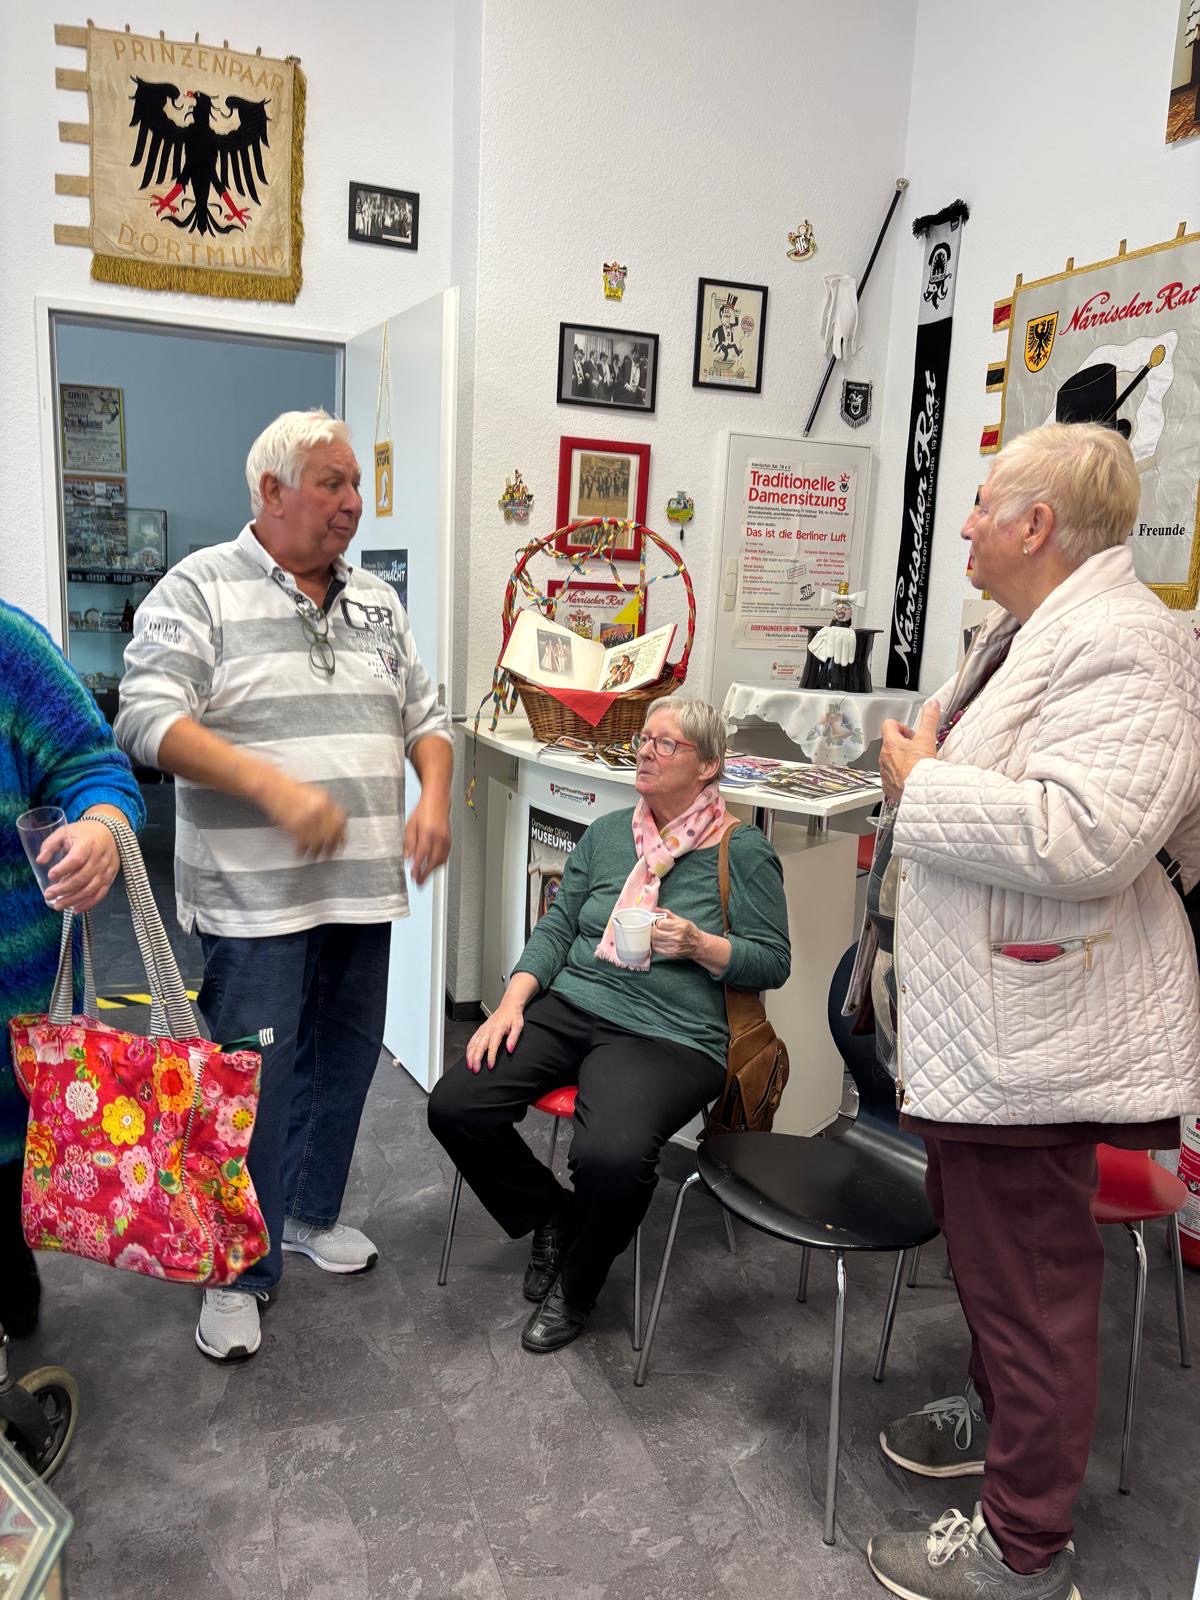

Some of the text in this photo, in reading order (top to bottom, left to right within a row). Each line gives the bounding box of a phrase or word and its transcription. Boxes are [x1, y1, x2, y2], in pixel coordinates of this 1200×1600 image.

[112, 38, 285, 95] PRINZENPAAR
[118, 223, 284, 269] DORTMUND
[1059, 281, 1200, 336] Närrischer Rat
[931, 425, 939, 451] 1978
[750, 470, 836, 492] Traditionelle
[925, 457, 937, 507] Freunde
[748, 487, 847, 512] Damensitzung
[746, 527, 847, 543] Das ist die Berliner Luft
[893, 370, 937, 684] Närrischer Rat
[924, 513, 932, 536] und
[1138, 523, 1185, 537] Freunde
[918, 541, 929, 586] Prinzen
[562, 590, 625, 606] Närrischer Rat
[751, 624, 782, 632] DORTMUNDER
